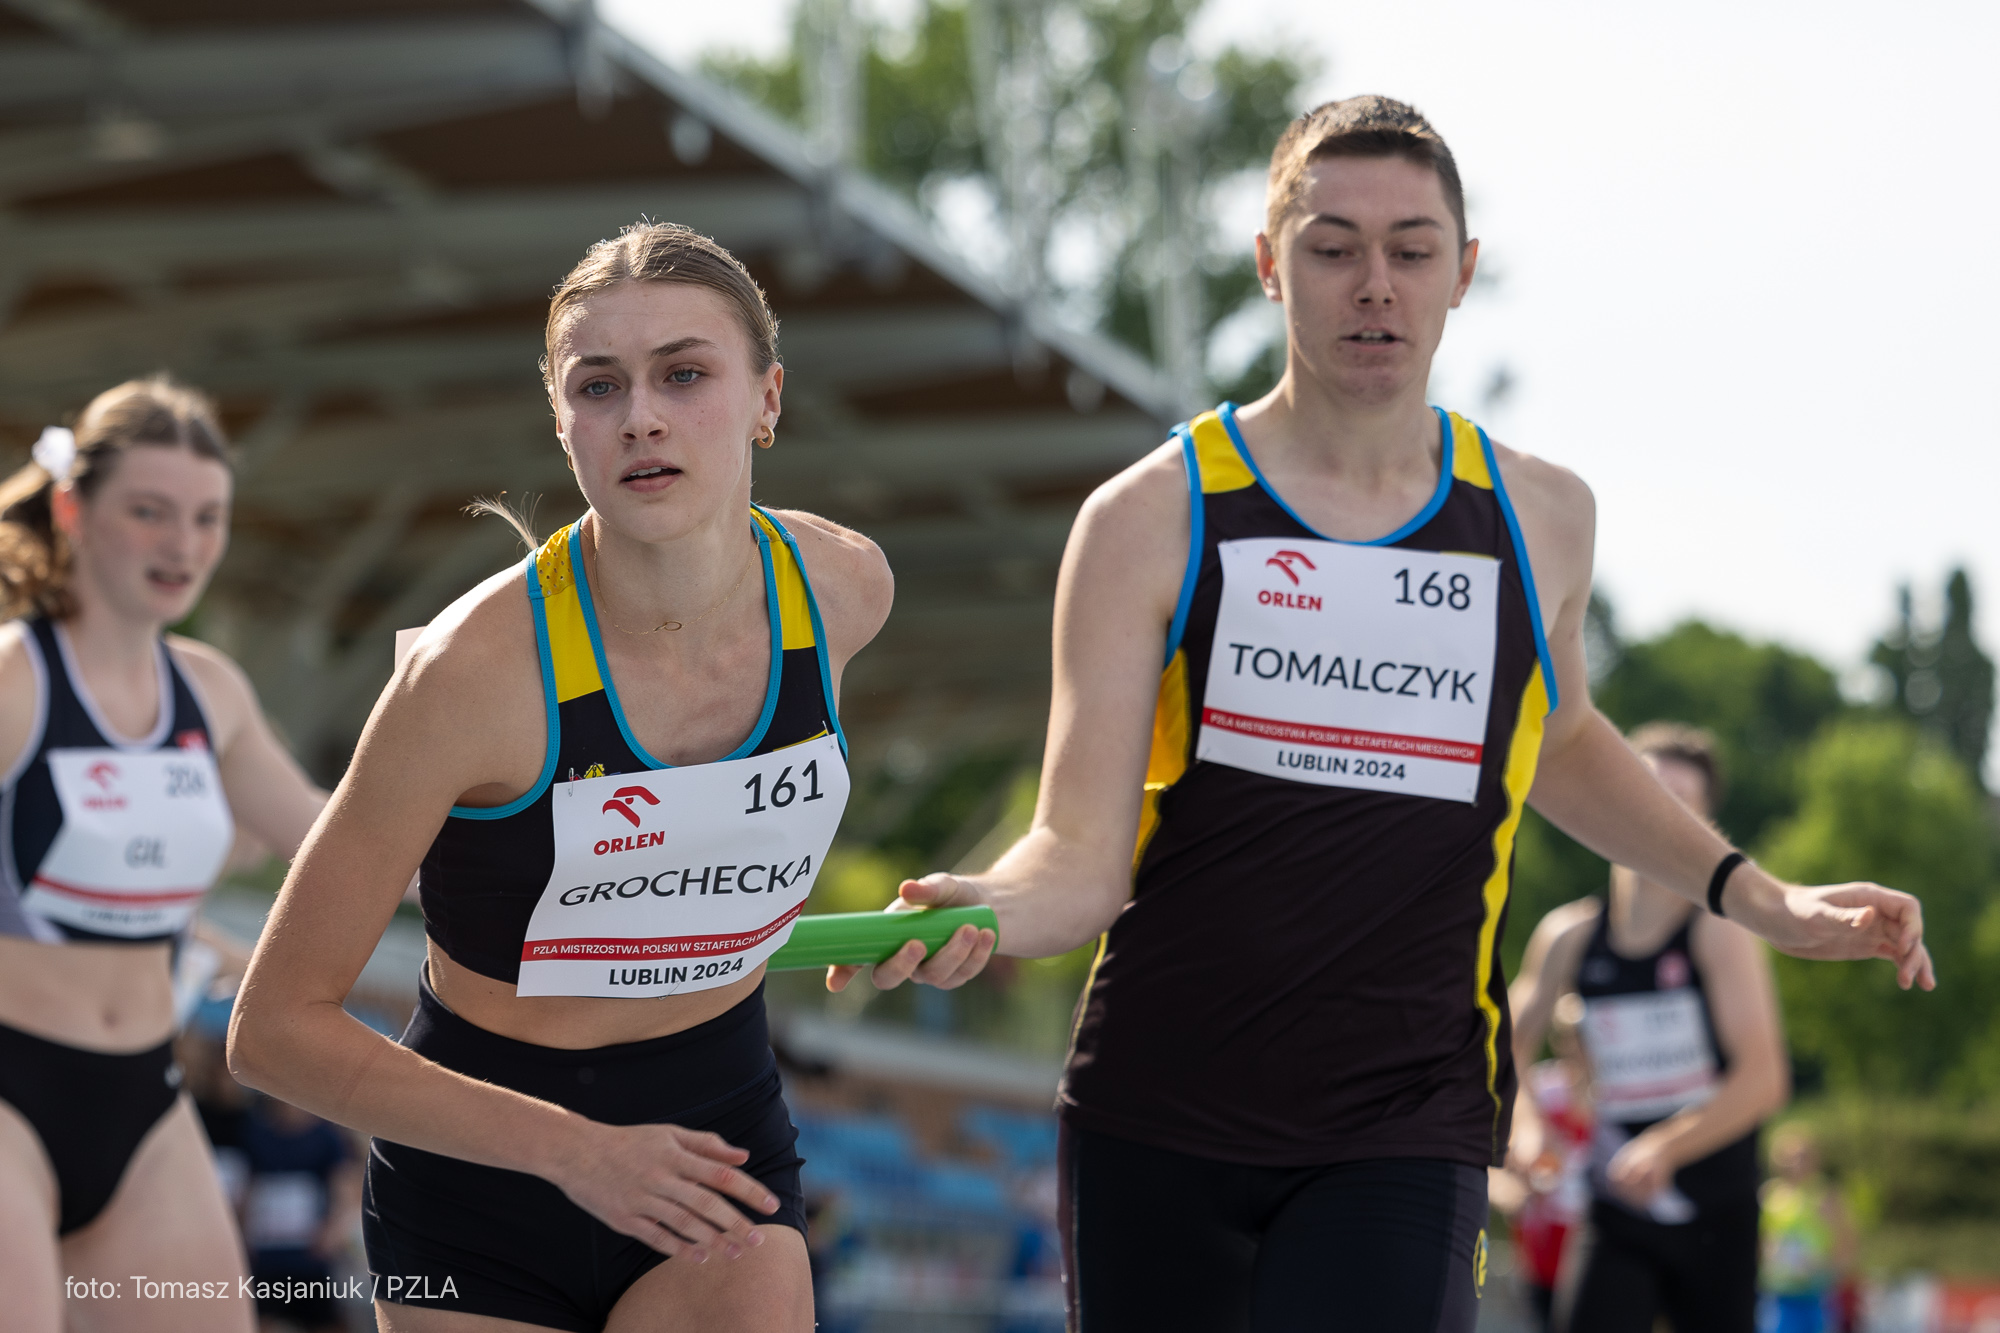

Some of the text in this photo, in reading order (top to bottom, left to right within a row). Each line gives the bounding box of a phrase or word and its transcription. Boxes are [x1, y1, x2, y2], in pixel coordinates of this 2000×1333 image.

[1257, 589, 1322, 612] ORLEN
[1394, 567, 1472, 612] 168
[1229, 642, 1478, 705] TOMALCZYK
[1210, 711, 1477, 760] PZLA MISTRZOSTWA POLSKI W SZTAFETACH MIESZANYCH
[743, 758, 825, 816] 161
[1277, 749, 1406, 780] LUBLIN 2024
[593, 830, 666, 857] ORLEN
[558, 854, 813, 907] GROCHECKA
[533, 905, 801, 955] PZLA MISTRZOSTWA POLSKI W SZTAFETACH MIESZANYCH
[608, 956, 745, 986] LUBLIN 2024
